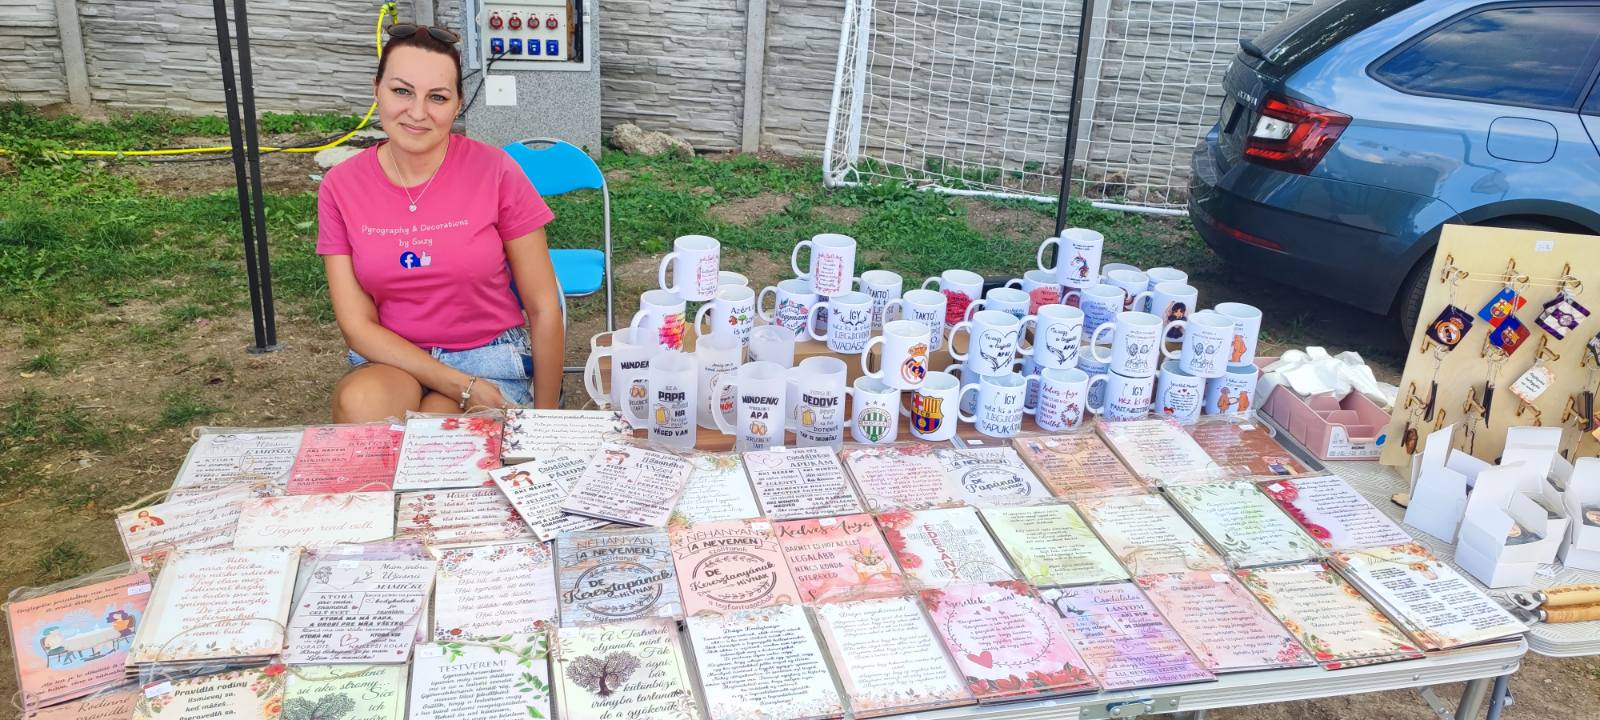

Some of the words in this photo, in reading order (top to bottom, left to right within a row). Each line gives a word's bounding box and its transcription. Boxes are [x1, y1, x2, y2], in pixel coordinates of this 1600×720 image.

[361, 224, 409, 236] Pyrography
[420, 219, 469, 231] Decorations
[399, 240, 410, 248] by
[412, 238, 433, 247] Suzy
[658, 390, 686, 402] PAPA
[803, 393, 839, 407] DEDOVE
[750, 411, 769, 420] APA
[675, 429, 689, 437] VAN
[549, 465, 587, 479] PÁROM
[779, 525, 829, 537] Kedves
[690, 543, 699, 551] A
[703, 538, 758, 548] NEVEMEN
[592, 547, 651, 557] NEVEMEN
[790, 551, 836, 562] LEGALÁBB
[705, 568, 722, 577] DE
[794, 563, 819, 573] NINCS
[820, 562, 844, 570] RONDA
[690, 562, 775, 591] Keresztanyának
[736, 573, 769, 585] HÍVNAK
[563, 571, 673, 605] Keresztapának
[589, 579, 604, 588] DE
[600, 631, 613, 642] A
[617, 626, 669, 639] Testvérek
[639, 638, 660, 646] mint
[640, 646, 670, 658] Fák
[648, 669, 666, 678] bár
[174, 685, 214, 697] Pravidlá
[217, 681, 248, 690] rodiny
[623, 679, 676, 692] különböző
[368, 701, 385, 711] ich
[591, 697, 633, 709] irányba
[599, 709, 613, 720] de
